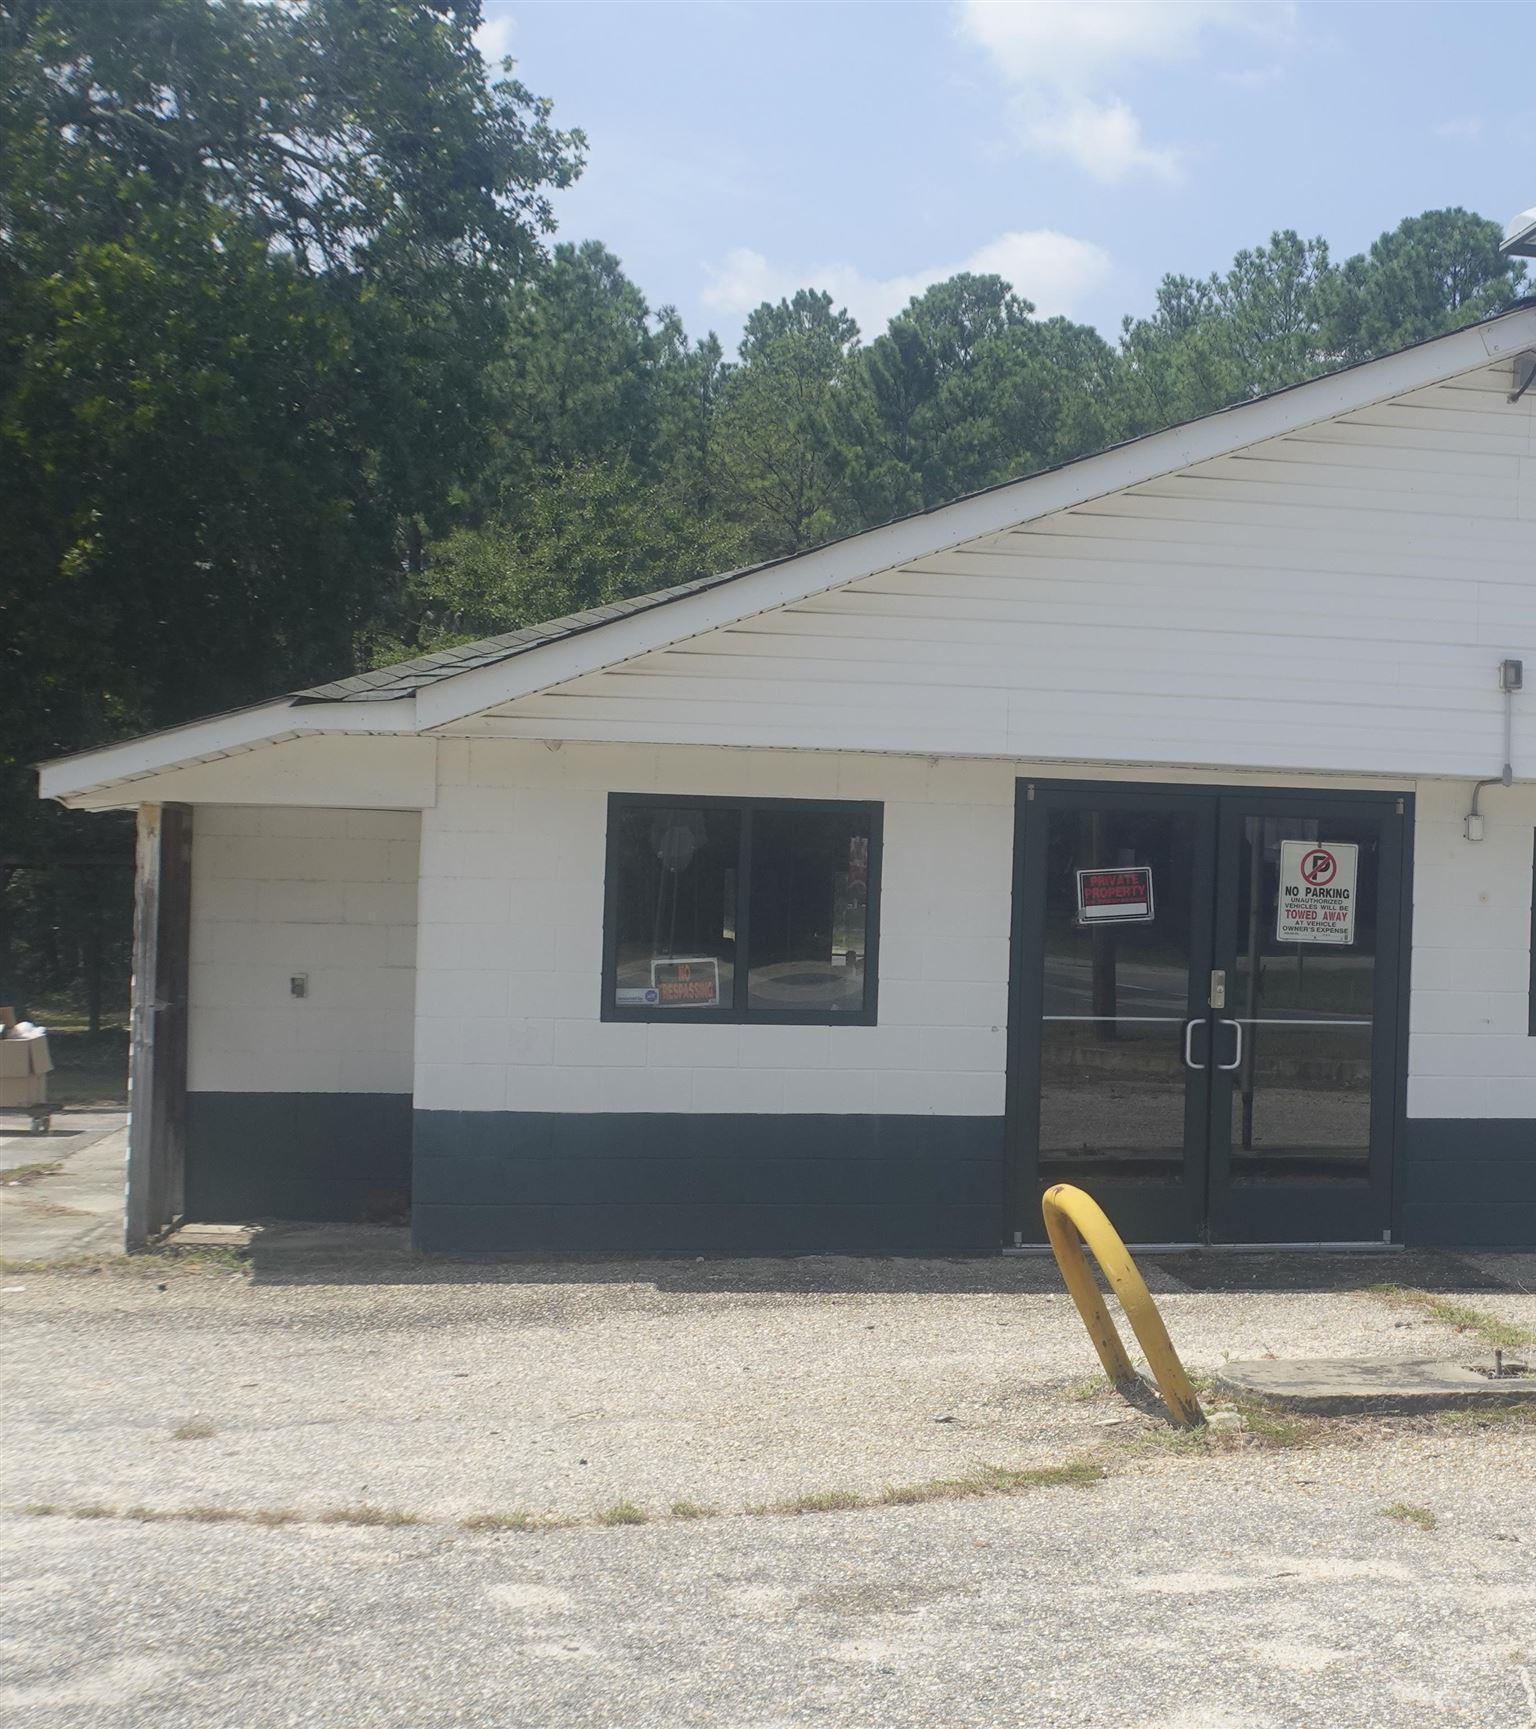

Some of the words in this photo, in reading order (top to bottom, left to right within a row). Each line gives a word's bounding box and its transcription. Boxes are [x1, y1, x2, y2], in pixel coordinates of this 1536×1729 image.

[1090, 873, 1140, 886] PRIVATE
[1084, 885, 1146, 898] PROPERTY
[1285, 886, 1299, 896] NO
[1305, 887, 1350, 899] PARKING
[1284, 902, 1318, 910] VEHICLES
[1290, 897, 1343, 905] UNAUTHORIZED
[1285, 909, 1318, 920] TOWED
[1322, 911, 1349, 922] AWAY
[1282, 925, 1315, 933] OWNER'S
[677, 963, 692, 981] NO
